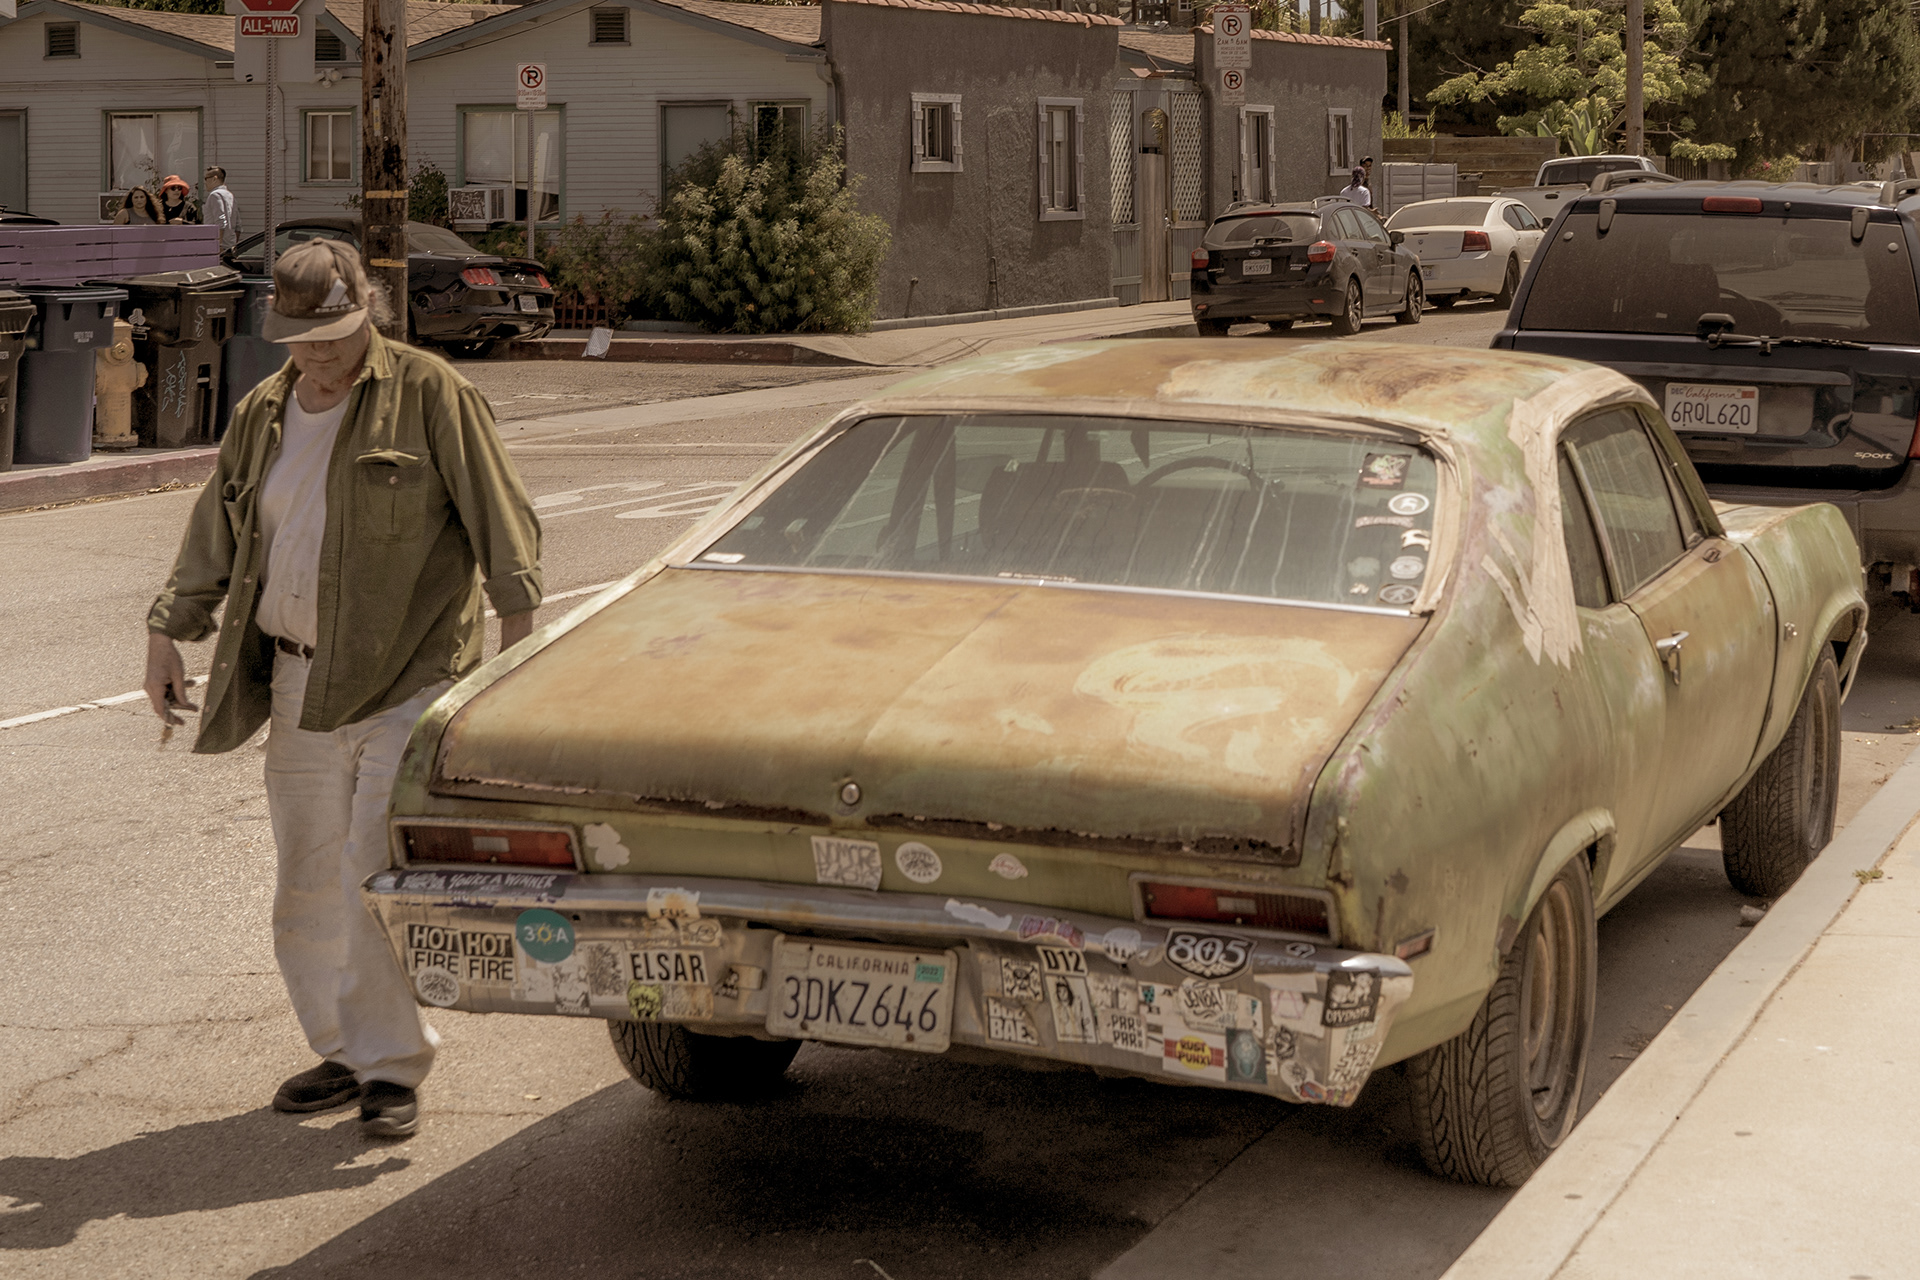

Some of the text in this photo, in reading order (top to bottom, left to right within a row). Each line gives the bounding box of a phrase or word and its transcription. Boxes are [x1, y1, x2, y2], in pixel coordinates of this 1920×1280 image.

[242, 19, 297, 33] ALL-WAY
[1685, 386, 1736, 401] California
[1671, 401, 1751, 426] 6RQL620
[504, 873, 557, 889] WINNER
[412, 926, 458, 950] HOT
[465, 933, 510, 956] HOT
[1042, 949, 1085, 974] D12
[1168, 934, 1248, 968] 805
[469, 958, 514, 981] FIRE
[630, 952, 706, 983] ELSAR
[816, 953, 909, 975] CALIFORNIA
[783, 975, 939, 1033] 3DKZ646
